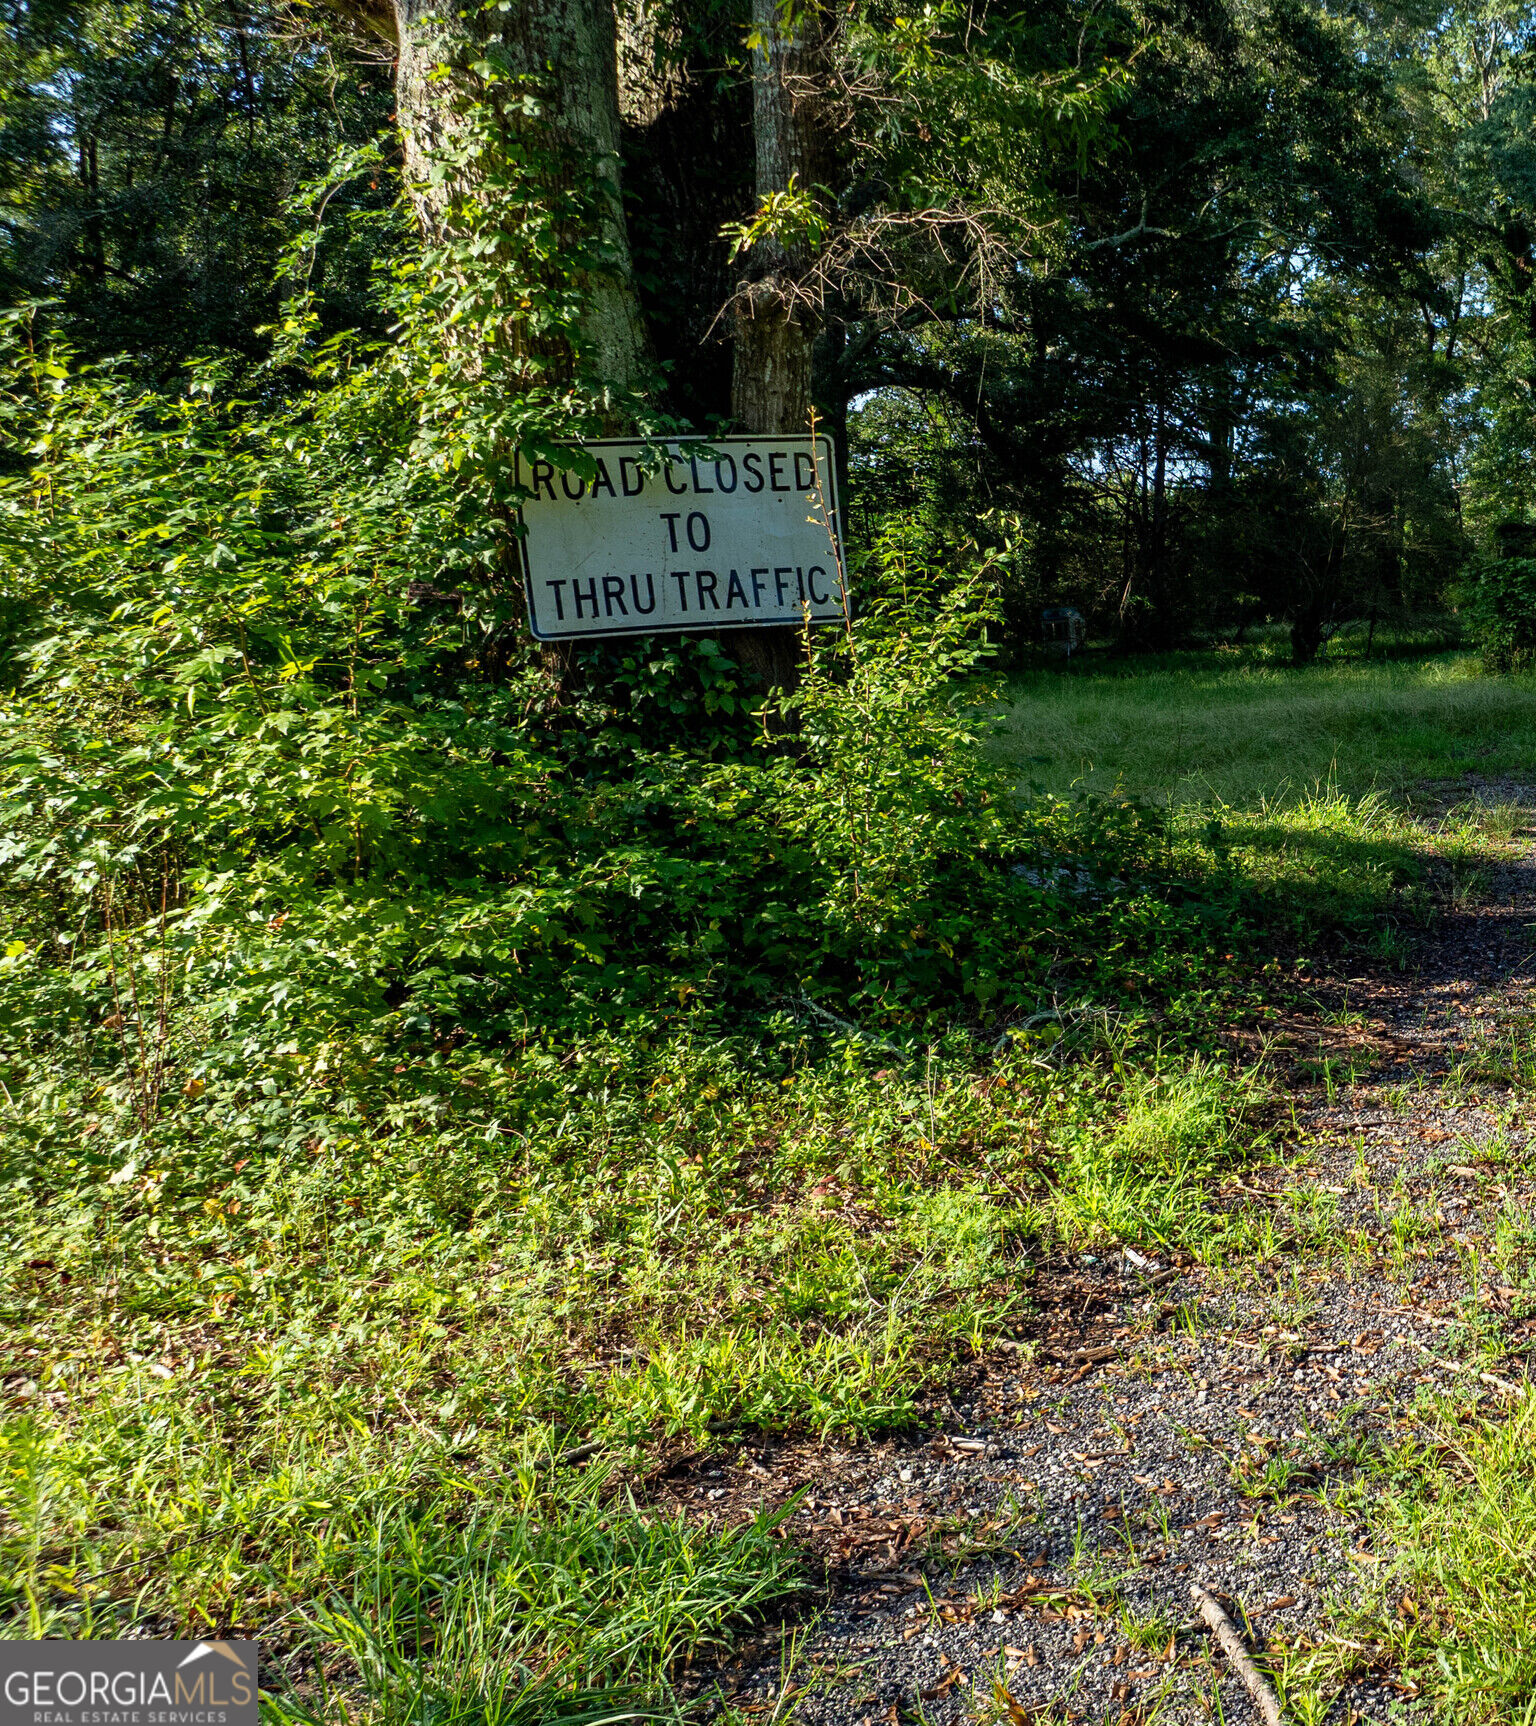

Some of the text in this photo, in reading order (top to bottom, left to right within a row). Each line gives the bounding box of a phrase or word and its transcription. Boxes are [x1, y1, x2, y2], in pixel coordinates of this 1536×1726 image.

[533, 452, 816, 501] ROAD CLOSED
[660, 511, 711, 553] TO
[546, 566, 830, 621] THRU TRAFFIC
